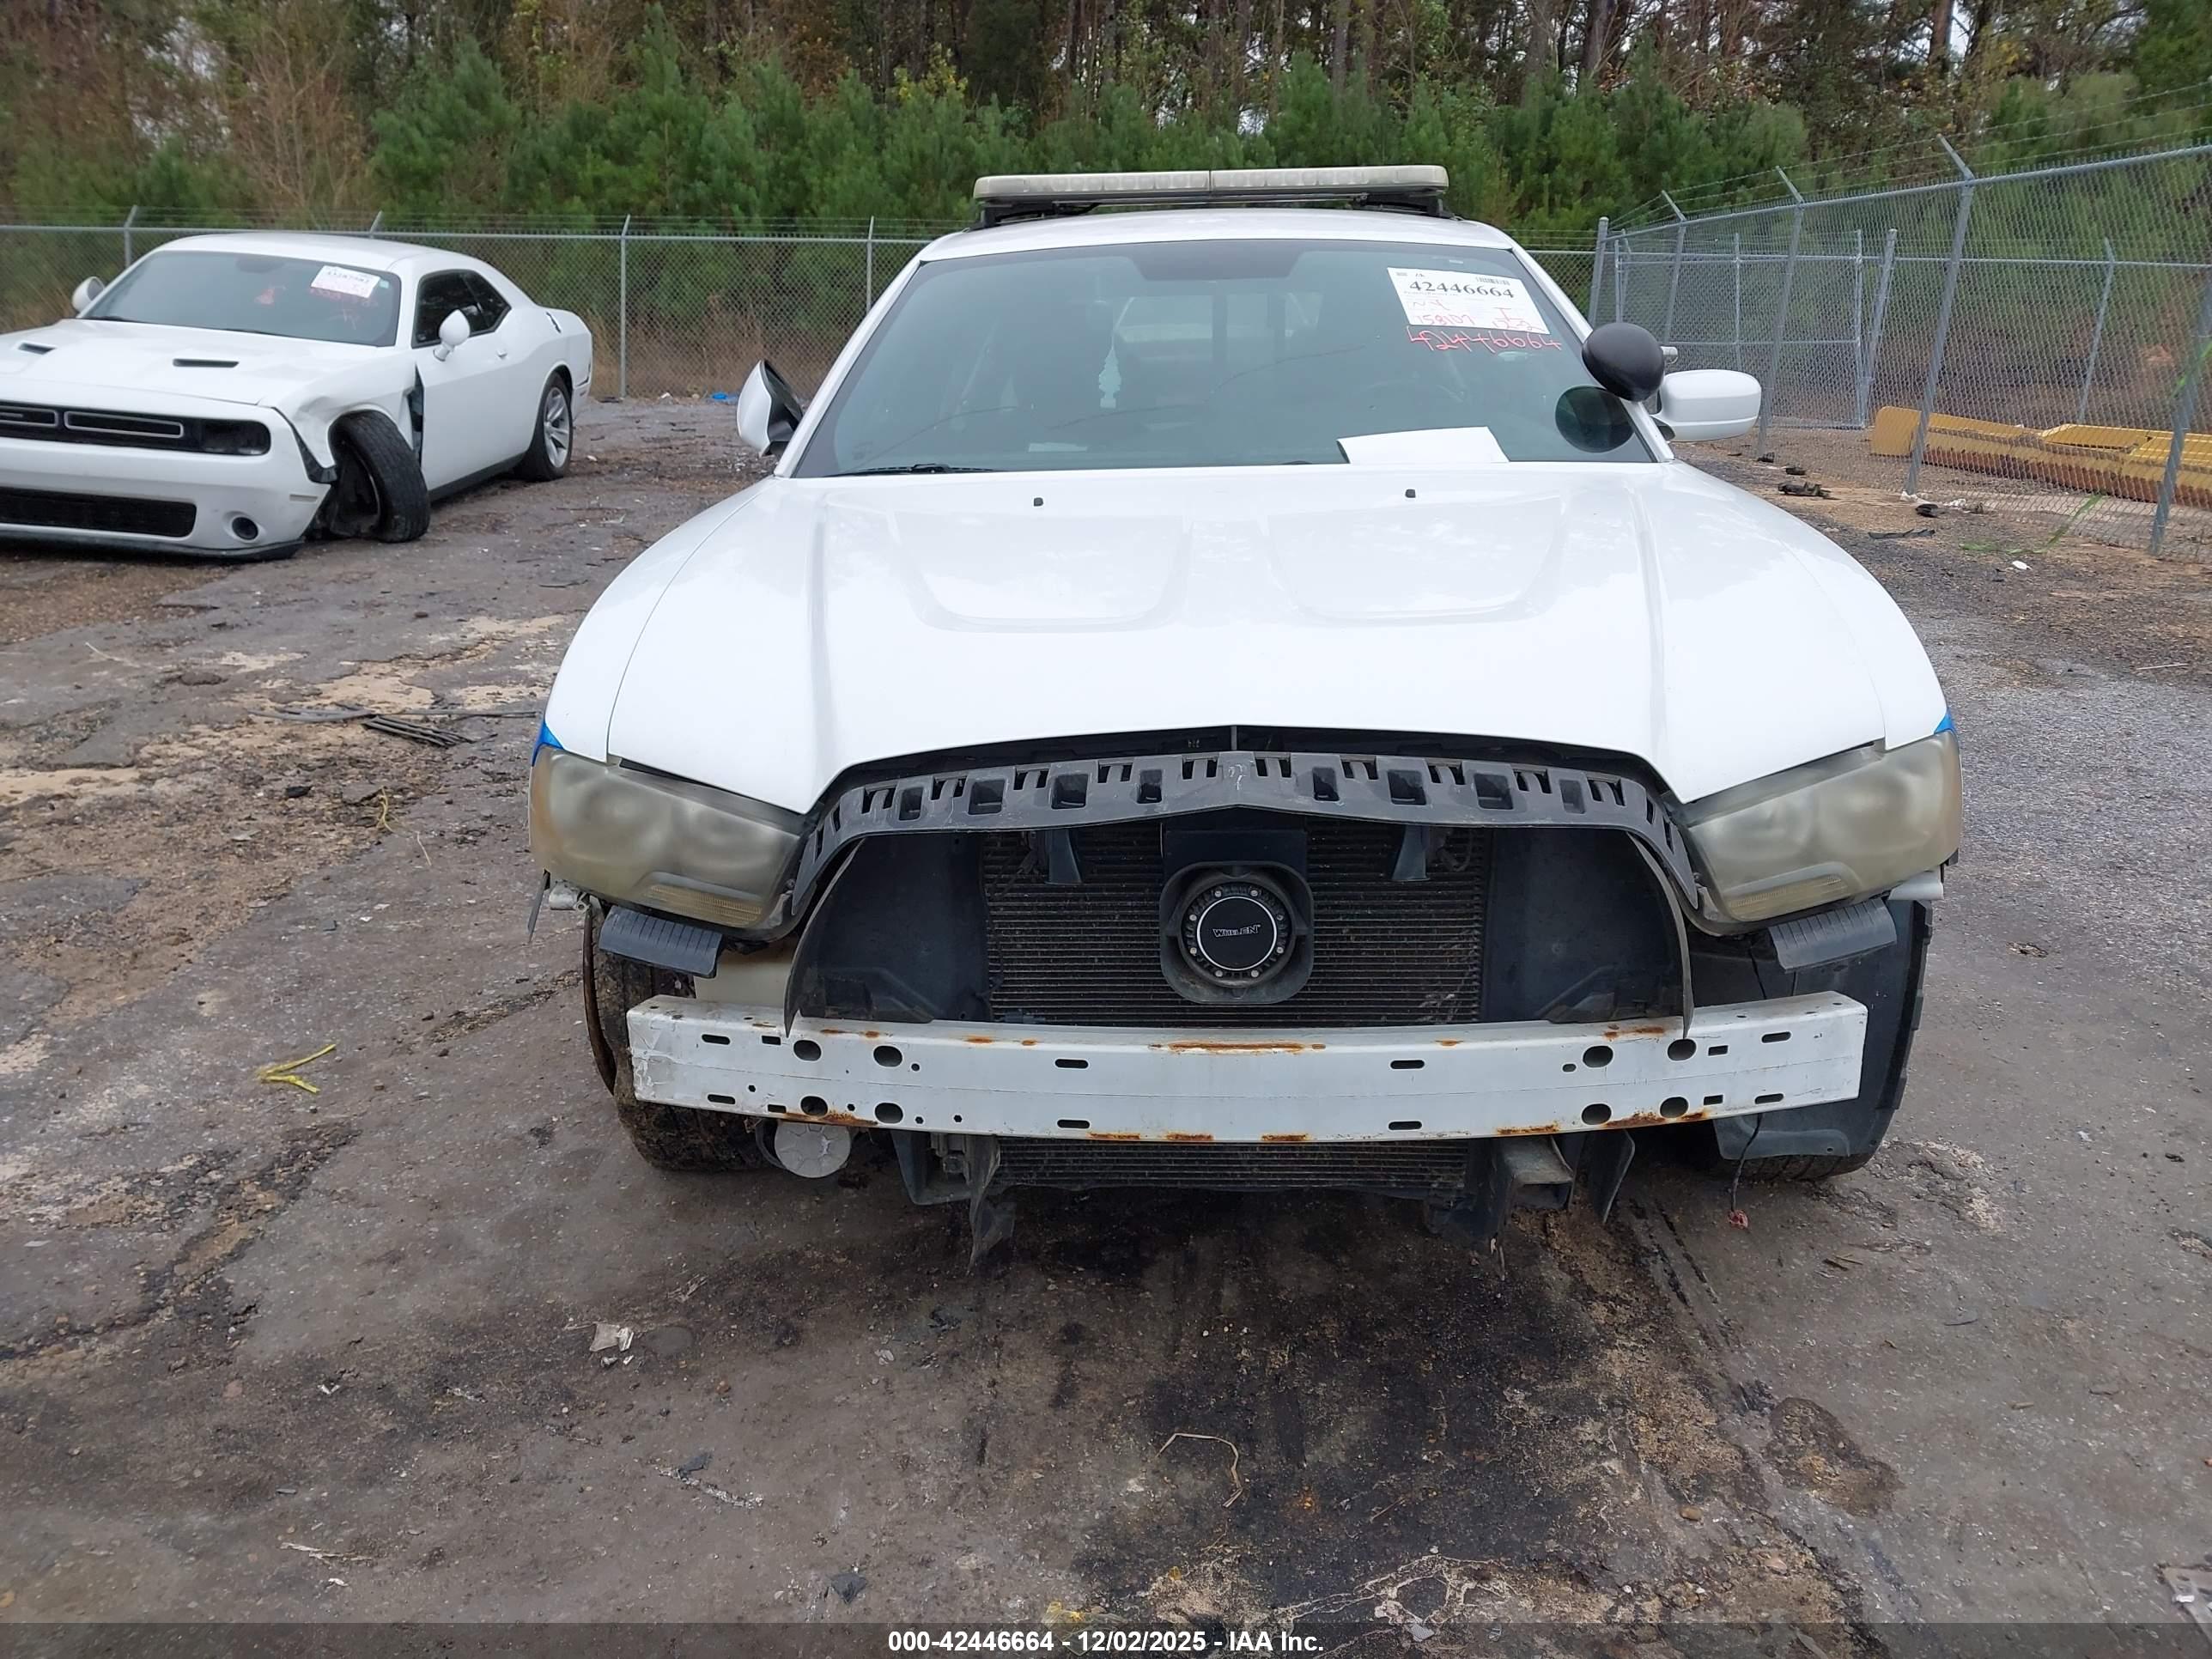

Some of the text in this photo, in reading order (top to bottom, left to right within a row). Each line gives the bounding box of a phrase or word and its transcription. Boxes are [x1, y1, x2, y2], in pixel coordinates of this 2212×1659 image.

[1409, 281, 1514, 298] 42446664
[1407, 325, 1562, 353] 42446664
[1212, 925, 1260, 938] WHELEN
